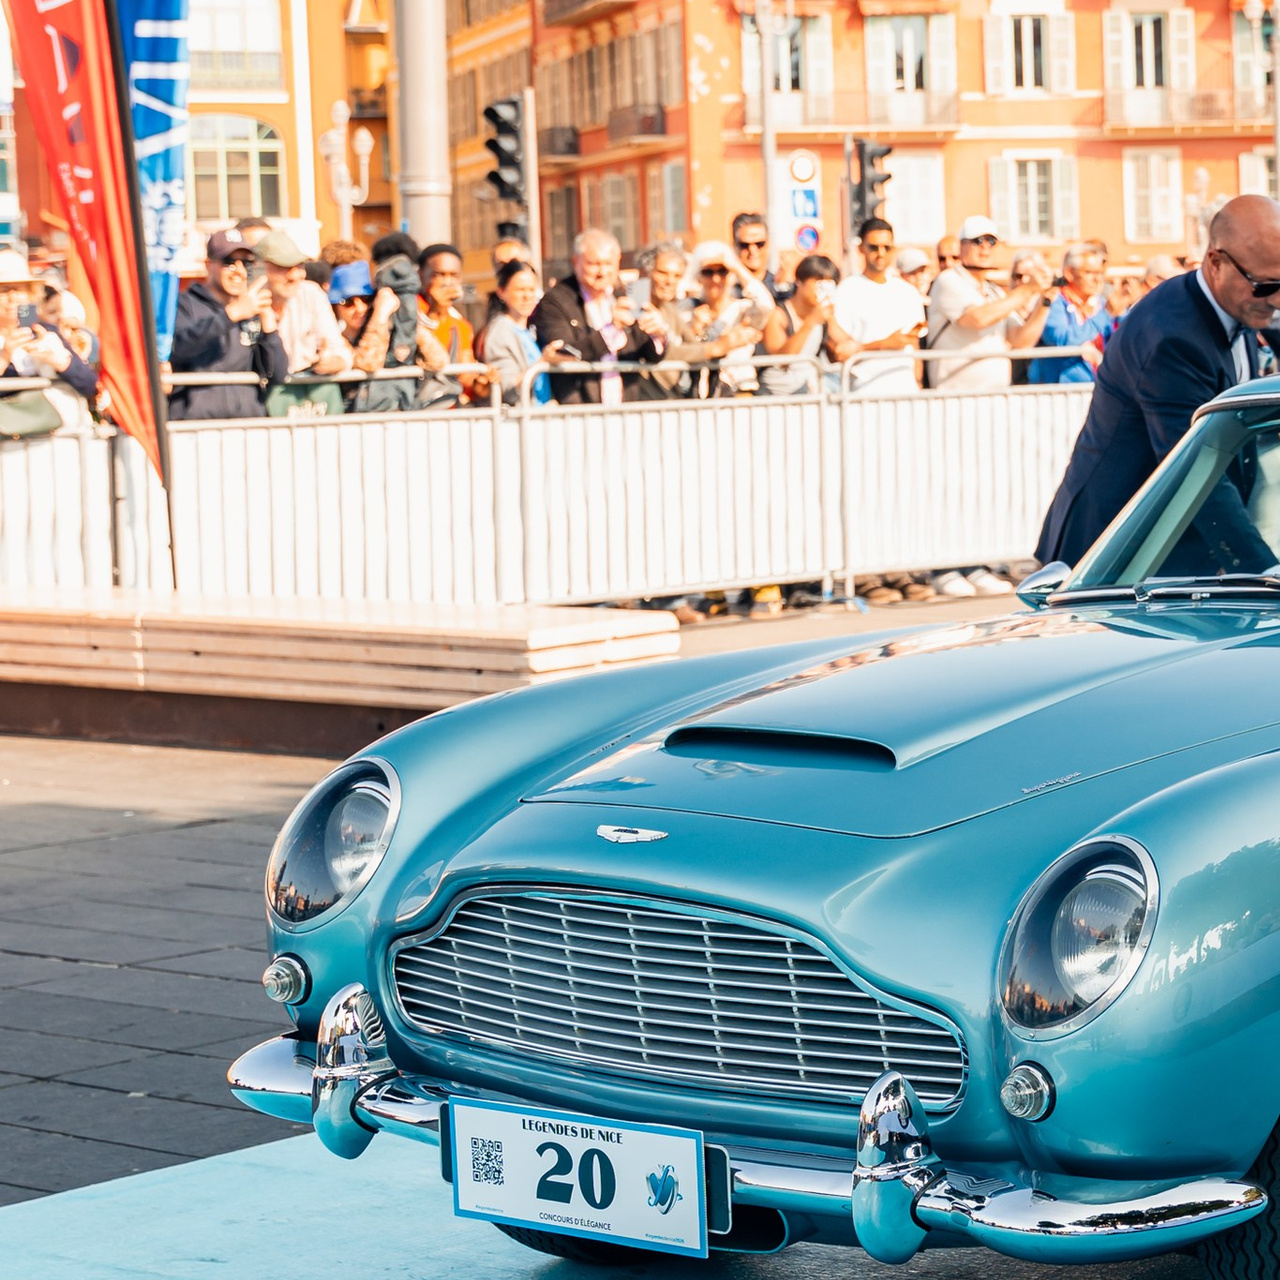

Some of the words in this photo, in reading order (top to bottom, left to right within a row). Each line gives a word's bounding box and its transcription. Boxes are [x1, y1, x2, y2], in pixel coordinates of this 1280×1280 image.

[521, 1118, 579, 1138] LEGENDES
[580, 1127, 597, 1140] DE
[597, 1129, 623, 1145] NICE
[535, 1141, 617, 1210] 20
[538, 1211, 574, 1225] CONCOURS
